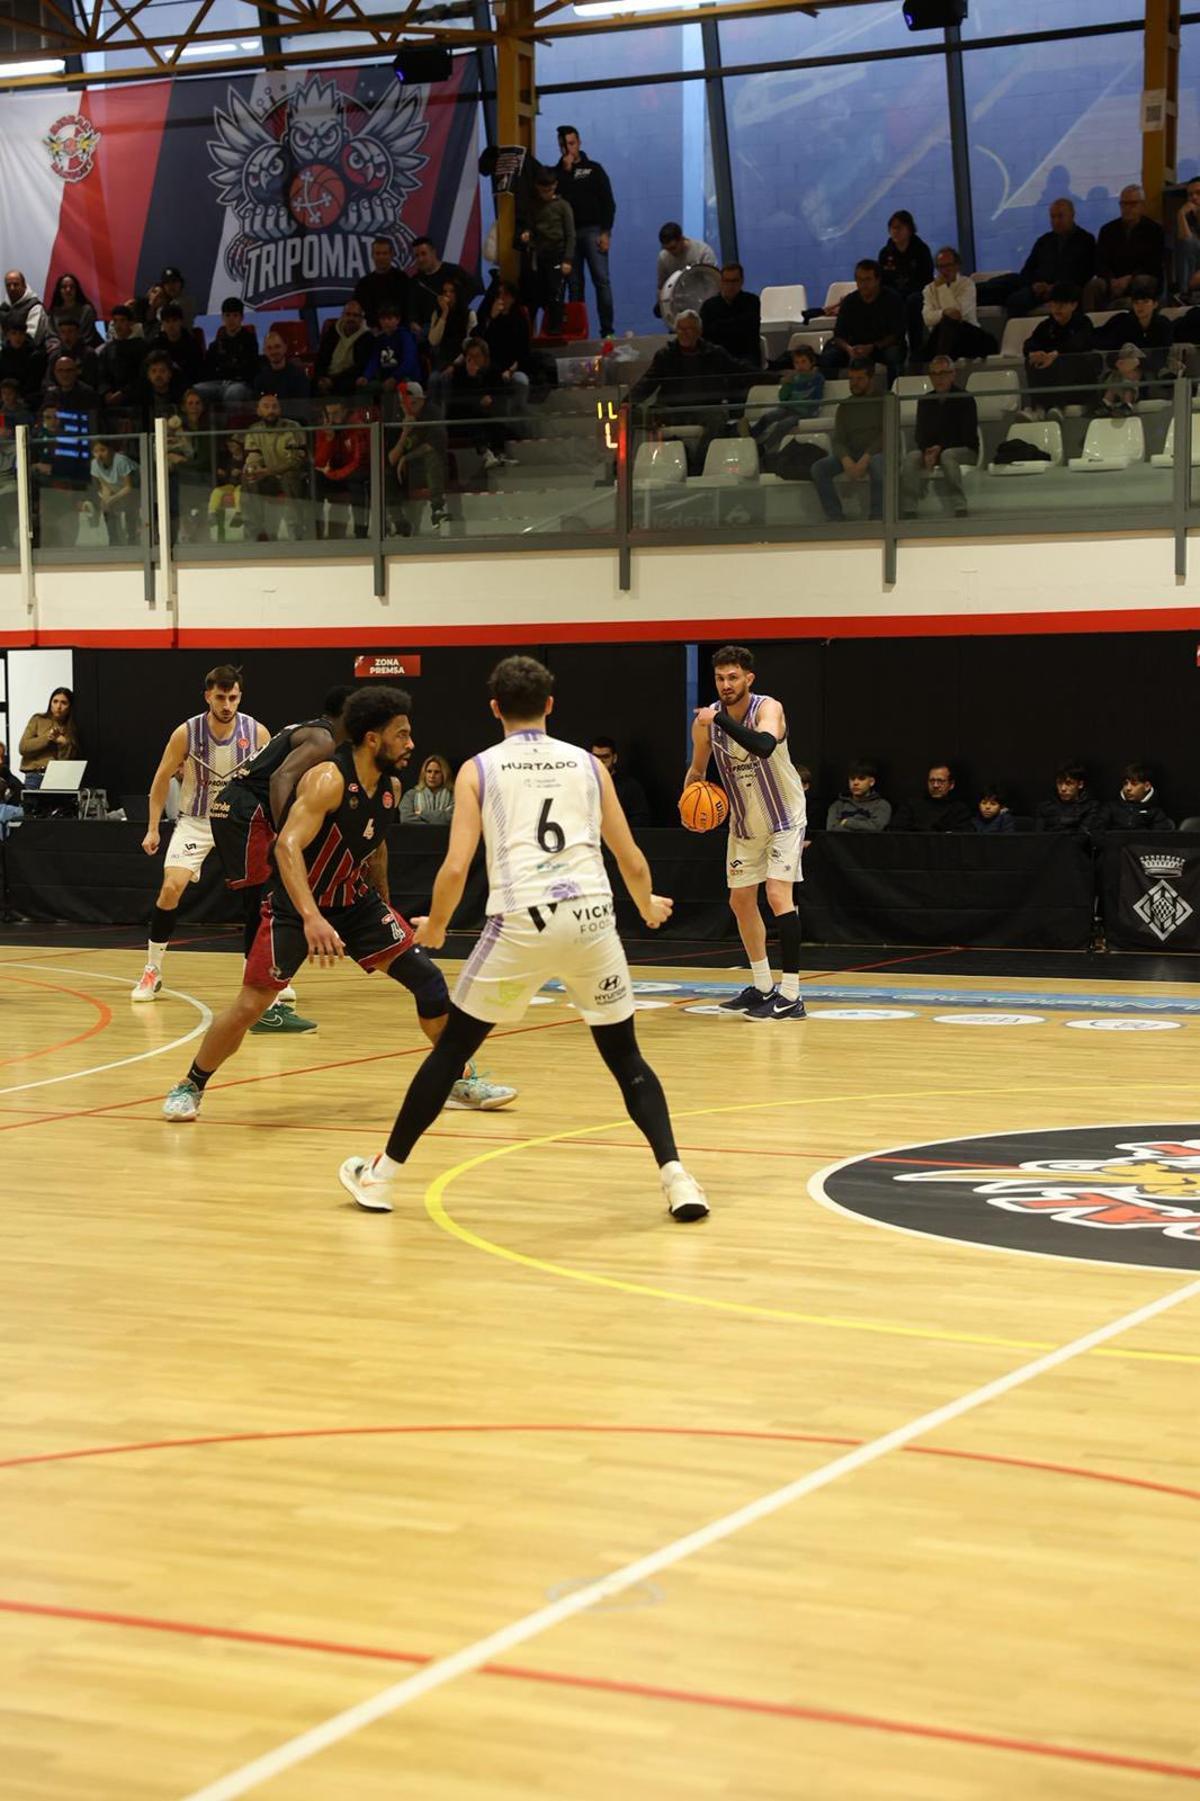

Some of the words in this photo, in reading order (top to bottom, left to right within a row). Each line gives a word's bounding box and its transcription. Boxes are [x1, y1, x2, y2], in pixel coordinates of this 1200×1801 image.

[374, 658, 400, 667] ZONA
[369, 666, 406, 675] PREMSA
[501, 760, 578, 771] HURTADO
[362, 817, 375, 841] 4
[537, 798, 566, 854] 6
